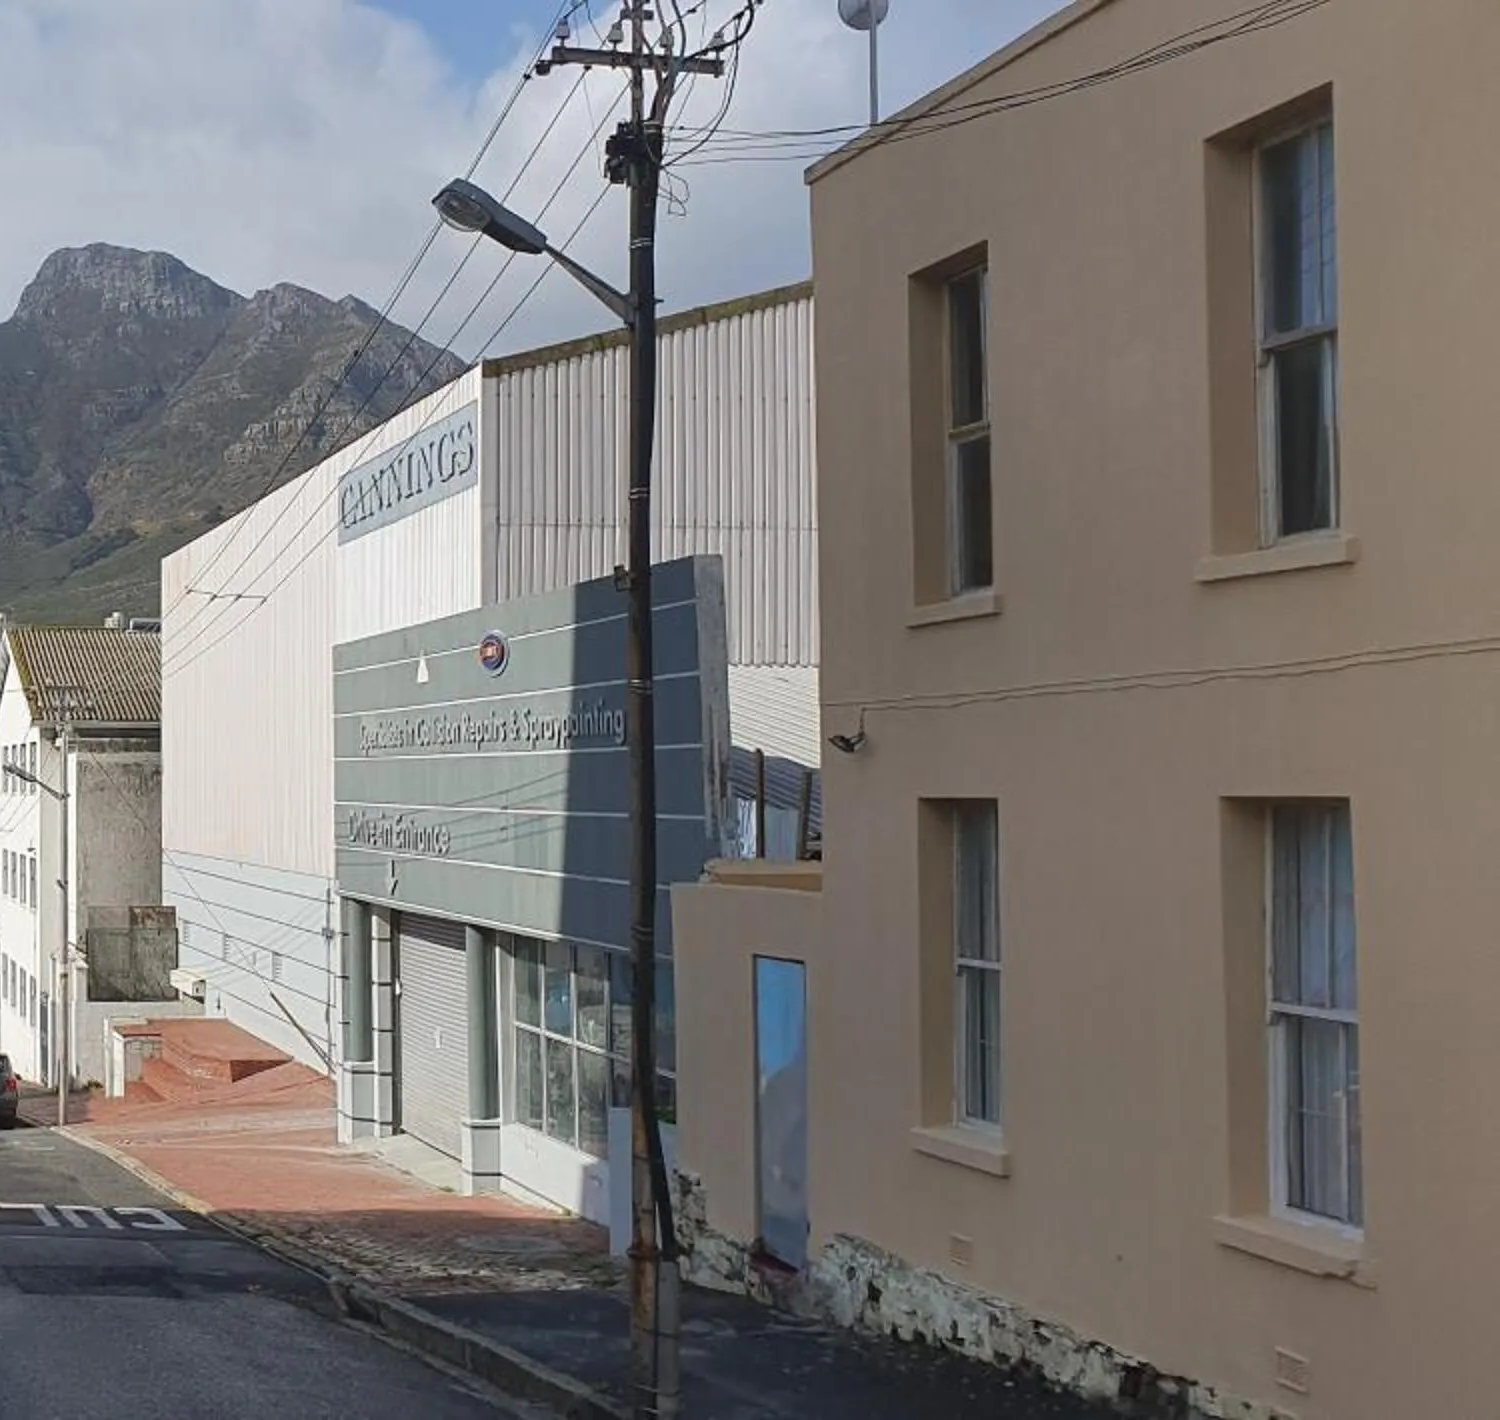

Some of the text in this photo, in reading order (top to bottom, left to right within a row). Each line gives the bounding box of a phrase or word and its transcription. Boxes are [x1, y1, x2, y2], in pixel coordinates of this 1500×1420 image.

[341, 420, 474, 529] CANNINGS
[462, 709, 507, 751] Repairs
[522, 698, 627, 750] Spraypainting
